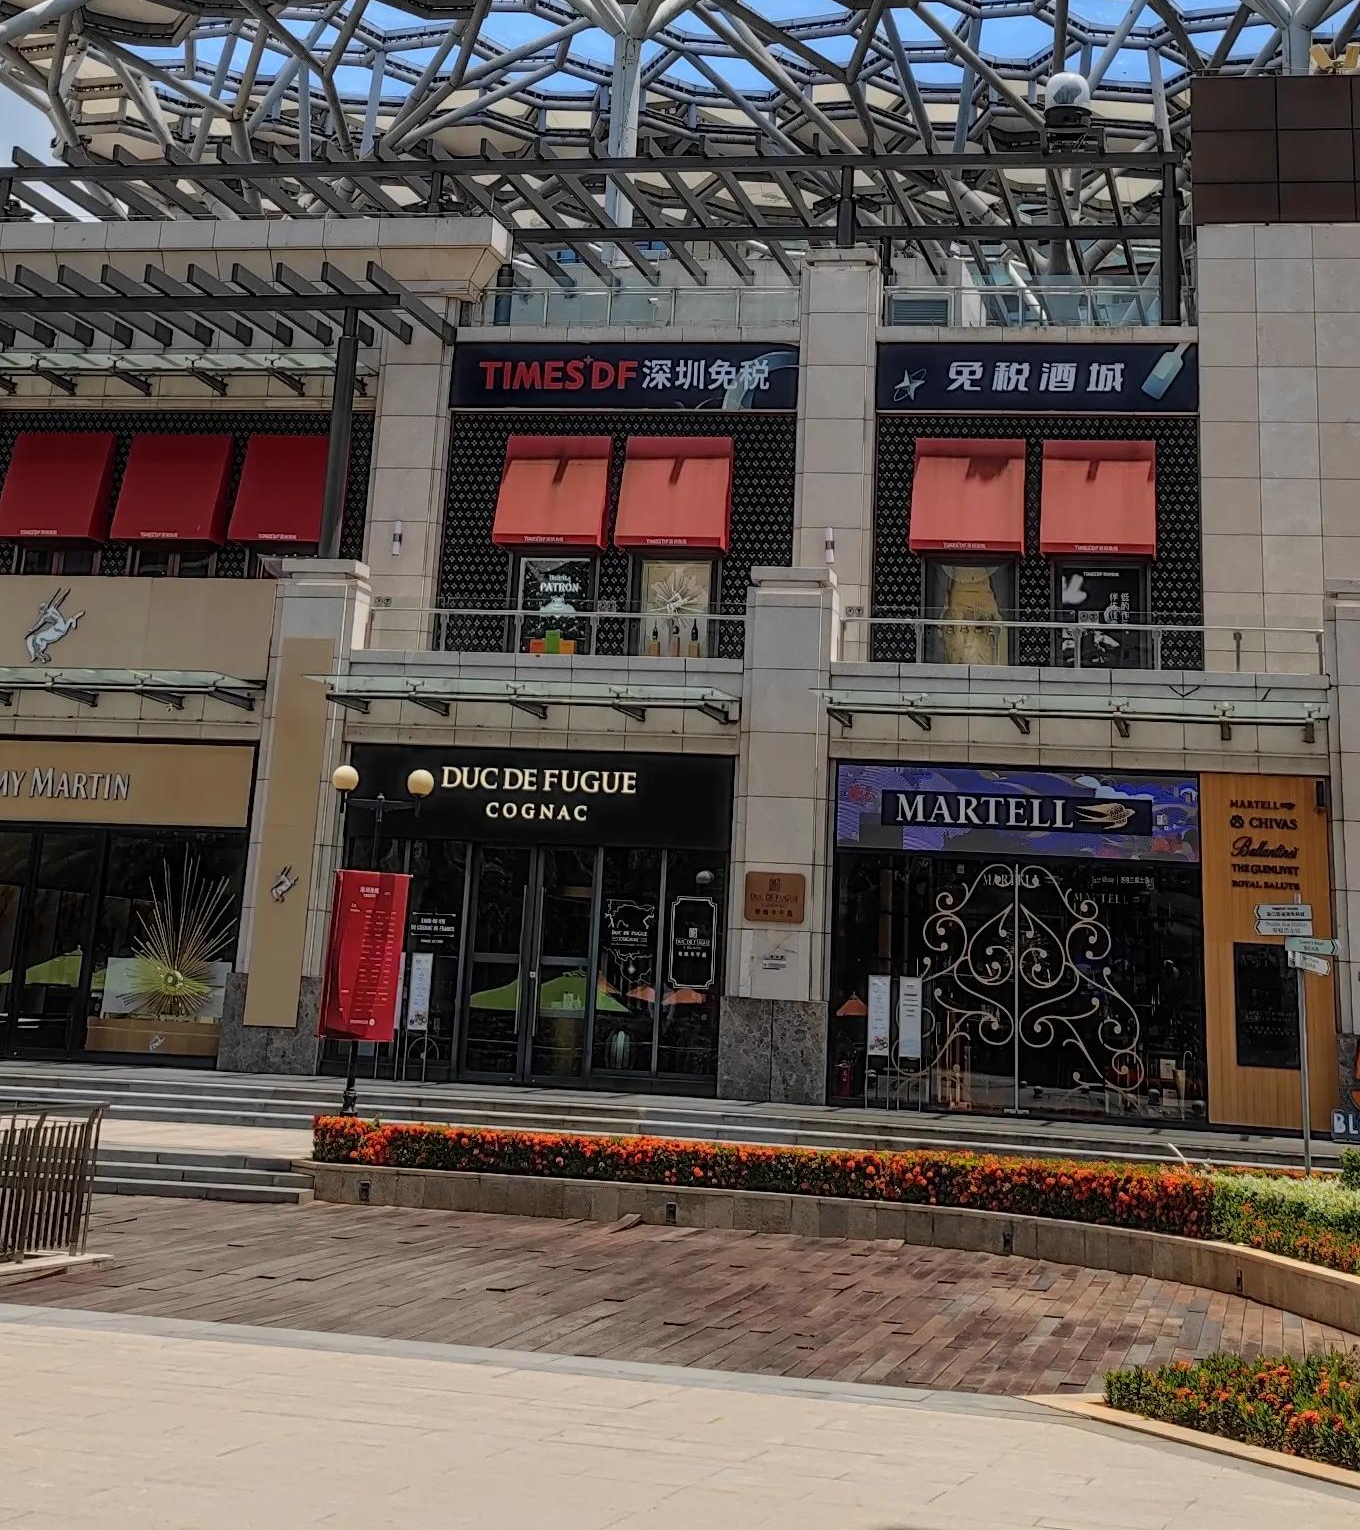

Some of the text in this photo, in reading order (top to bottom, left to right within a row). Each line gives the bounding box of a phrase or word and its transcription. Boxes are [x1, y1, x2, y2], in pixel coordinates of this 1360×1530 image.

[641, 359, 770, 390] 深圳免税
[946, 361, 1125, 392] 免税酒城
[29, 766, 130, 801] MARTIN
[441, 766, 637, 794] DUC DE FUGUE
[486, 802, 588, 821] COGNAC
[896, 793, 1074, 828] MARTELL
[1230, 799, 1280, 810] MARTELL
[1249, 817, 1298, 830] CHIVAS
[1232, 863, 1299, 876] THE GLENLIVET
[1232, 880, 1300, 891] ROYAL SALUTE
